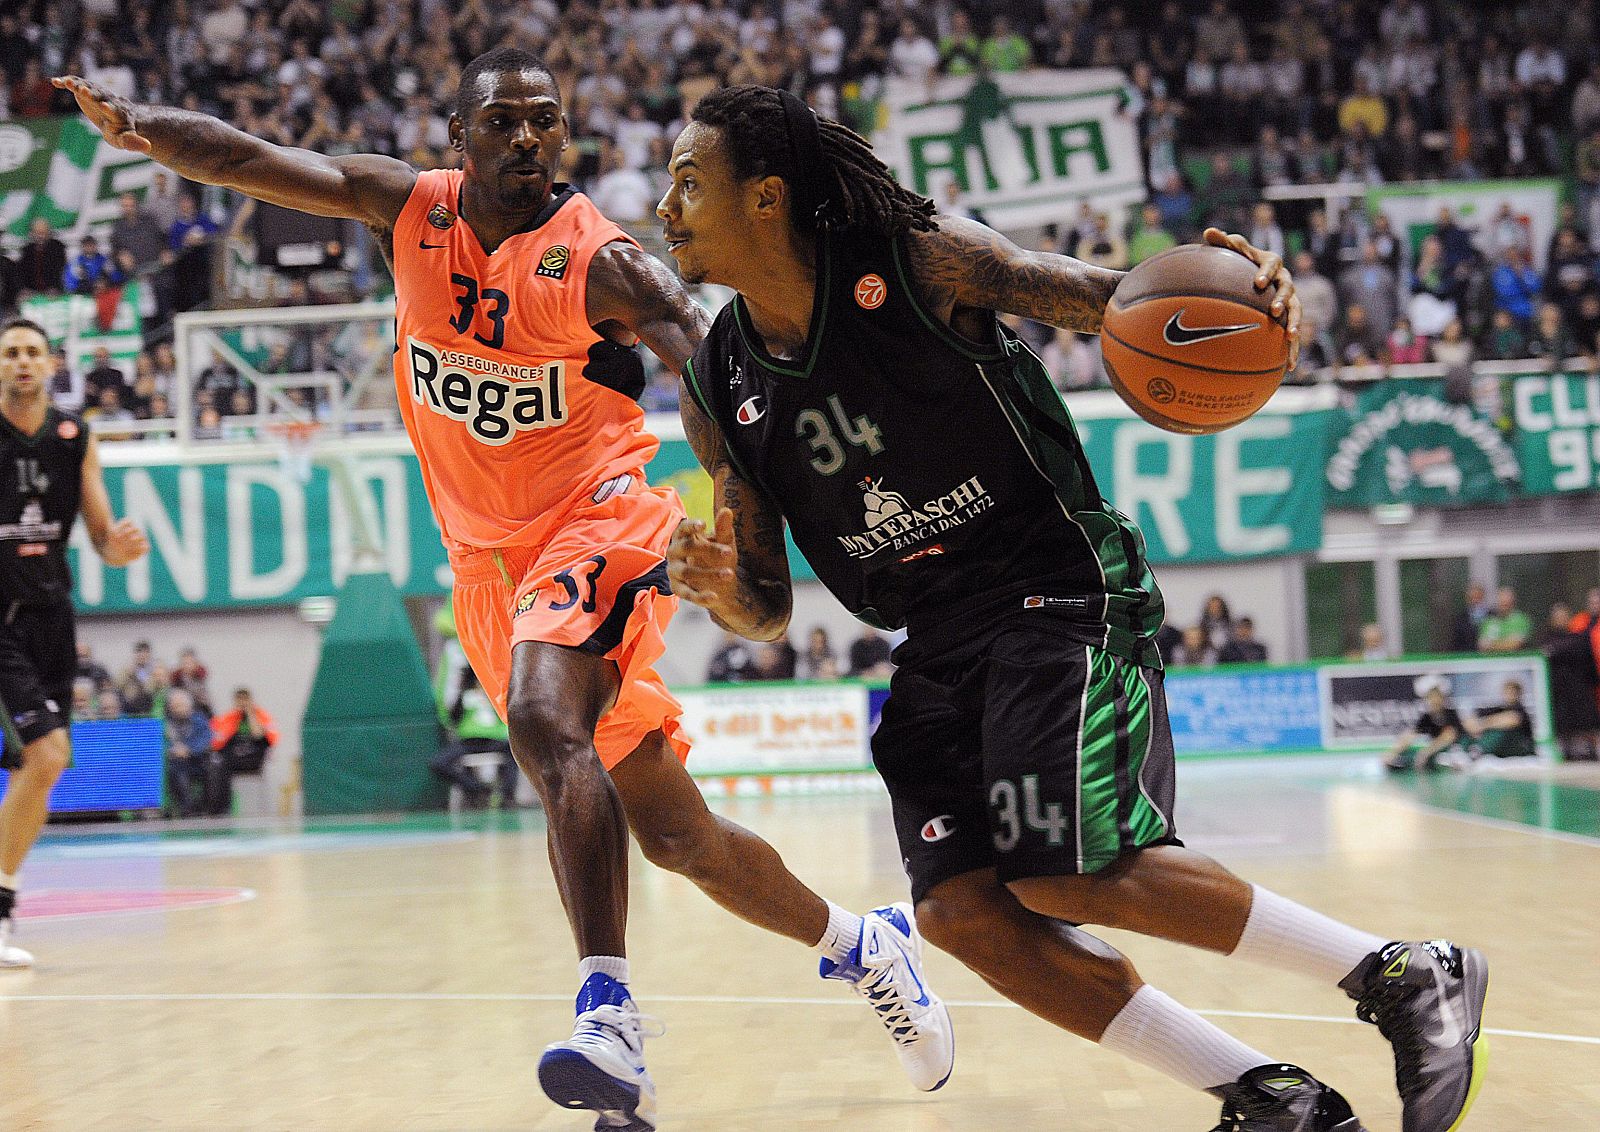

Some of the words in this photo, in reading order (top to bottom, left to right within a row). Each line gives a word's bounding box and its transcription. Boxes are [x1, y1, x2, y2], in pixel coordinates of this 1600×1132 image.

[449, 272, 510, 350] 33
[537, 268, 561, 278] 2010
[408, 340, 565, 441] Regal
[440, 351, 545, 381] ASSEGURANCES
[794, 393, 887, 477] 34
[836, 475, 988, 555] MNTEPASCHI
[893, 525, 939, 551] BANCA
[938, 513, 967, 532] DAL
[965, 495, 995, 520] 1472
[989, 774, 1070, 851] 34
